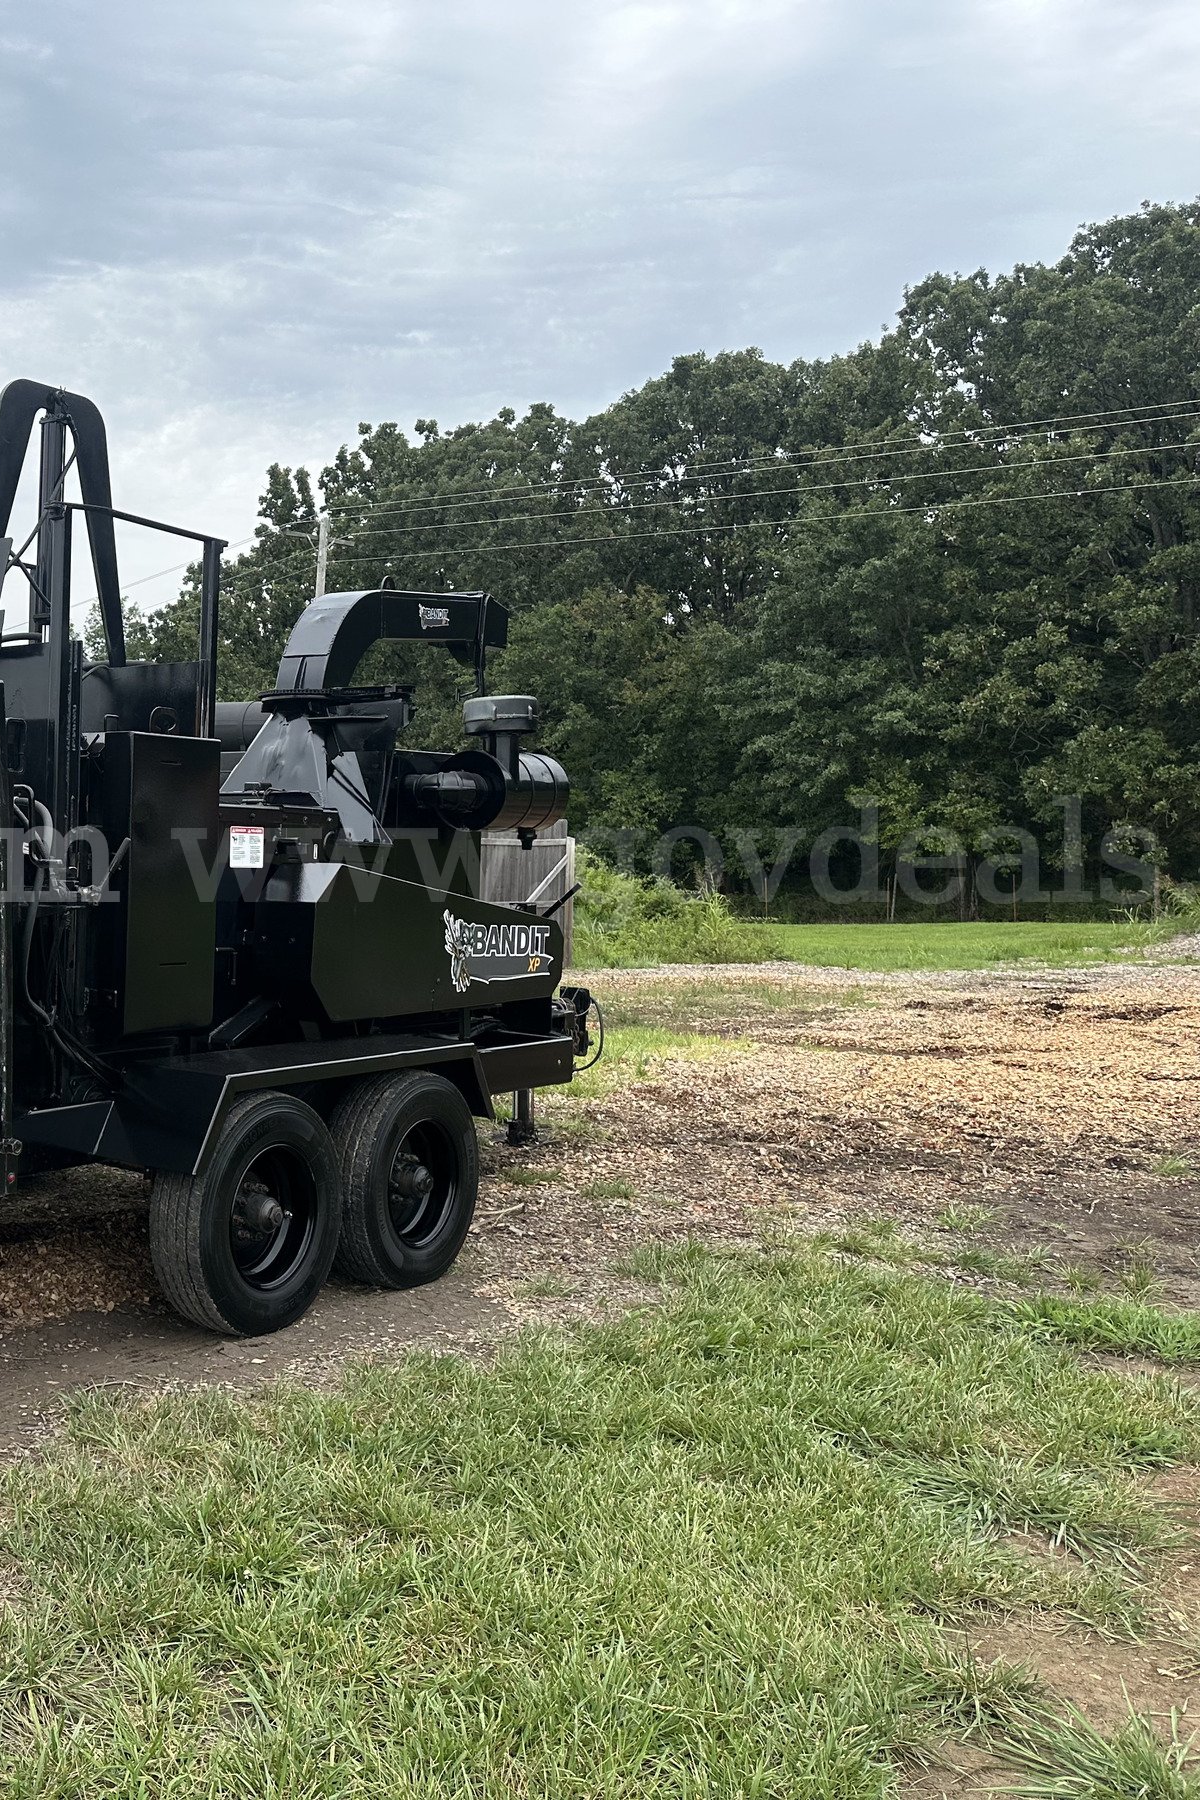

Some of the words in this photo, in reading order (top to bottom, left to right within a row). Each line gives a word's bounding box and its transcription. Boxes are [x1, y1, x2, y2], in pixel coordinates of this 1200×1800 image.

[426, 607, 449, 619] BANDIT
[471, 924, 550, 958] BANDIT
[527, 956, 541, 973] XP
